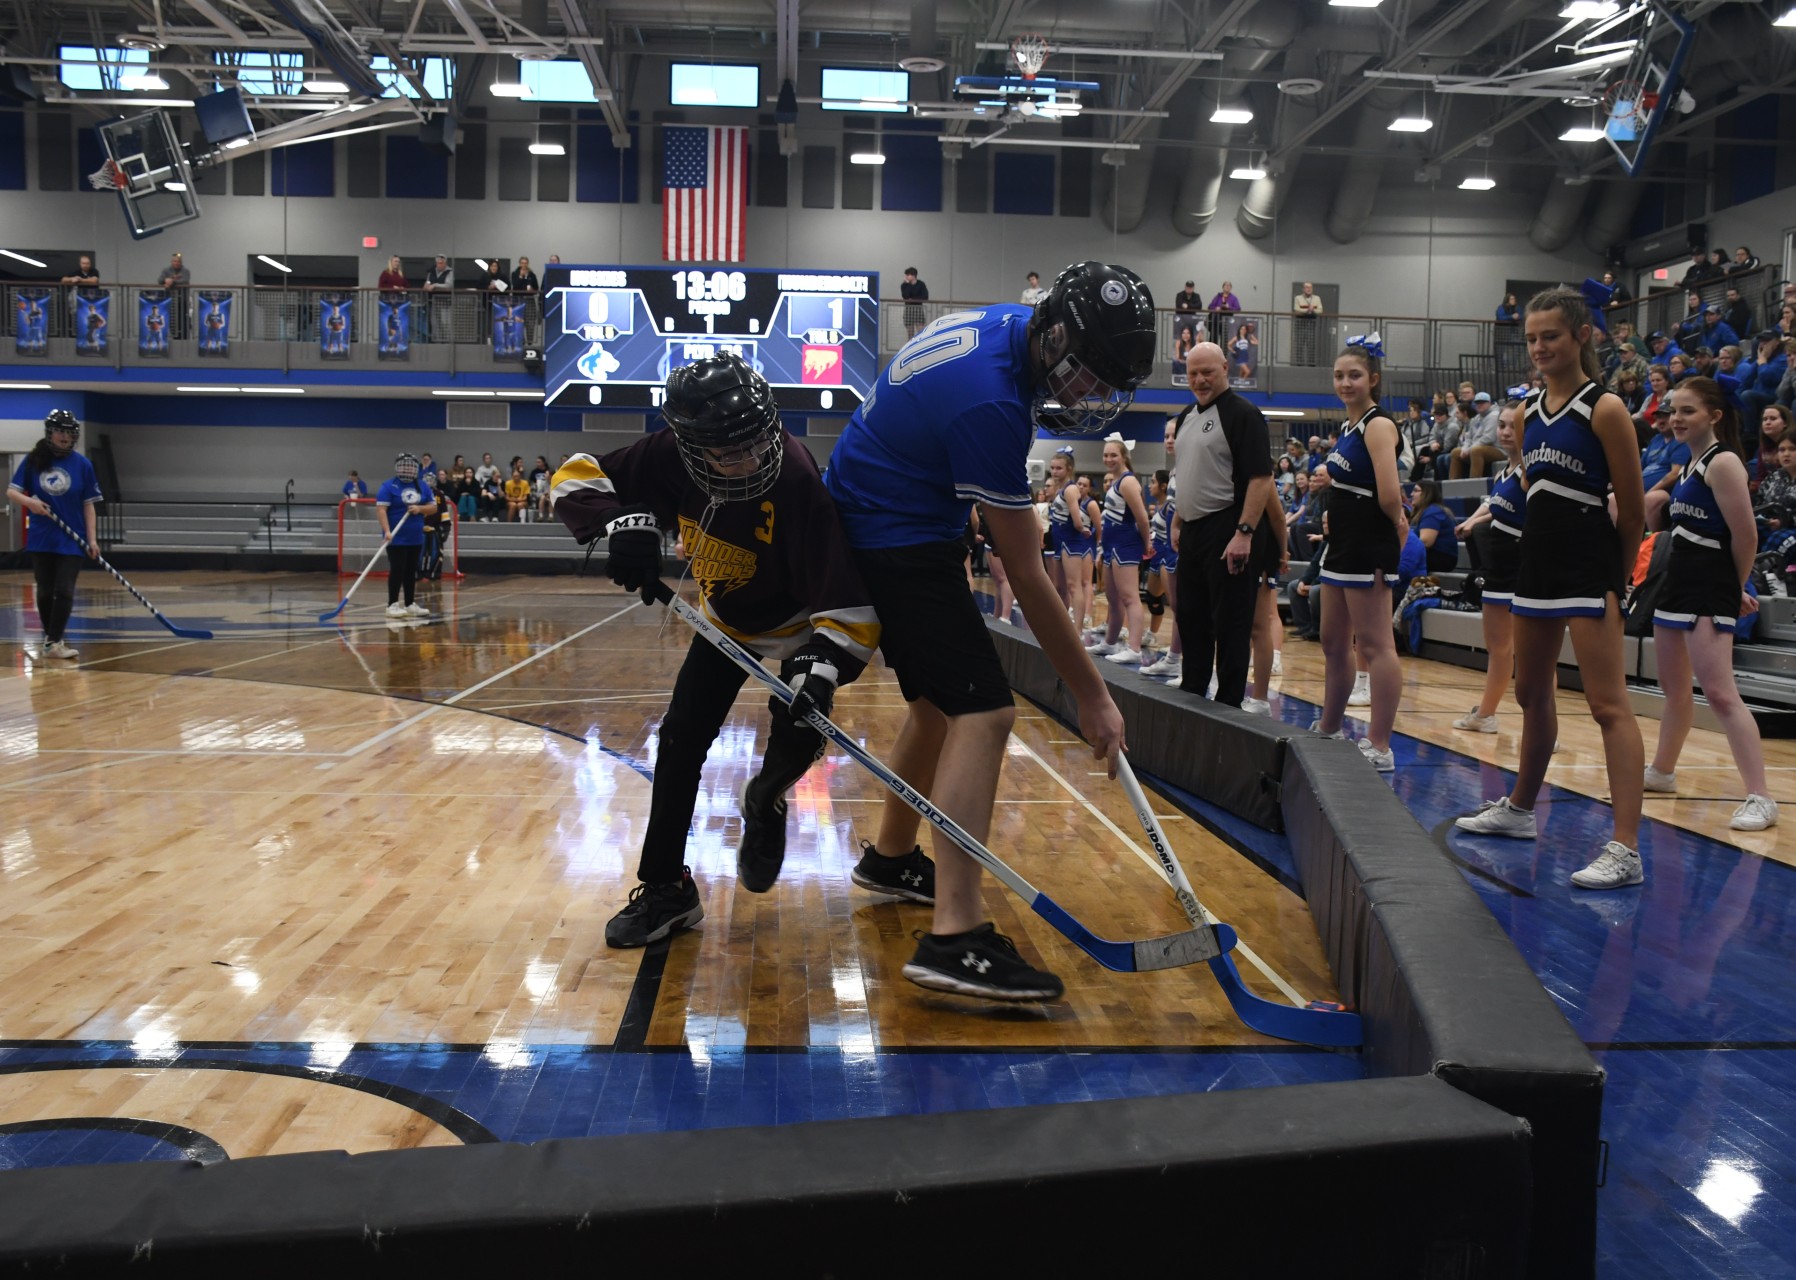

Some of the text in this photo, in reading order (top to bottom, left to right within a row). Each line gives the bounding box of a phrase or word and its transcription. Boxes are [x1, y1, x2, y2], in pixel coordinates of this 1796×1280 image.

[672, 271, 746, 301] 13:06
[588, 292, 608, 323] 0
[828, 298, 842, 329] 1
[703, 314, 714, 334] 1
[589, 385, 602, 405] 0
[820, 390, 834, 409] 0
[754, 500, 775, 545] 3
[678, 514, 757, 567] THUNDER
[692, 556, 757, 579] BOLTS
[686, 610, 711, 632] Dexter
[793, 654, 819, 662] MYLEC
[802, 690, 815, 704] PRO
[890, 779, 946, 827] 9300
[1140, 811, 1150, 826] PRO
[1180, 893, 1201, 924] Jesse
